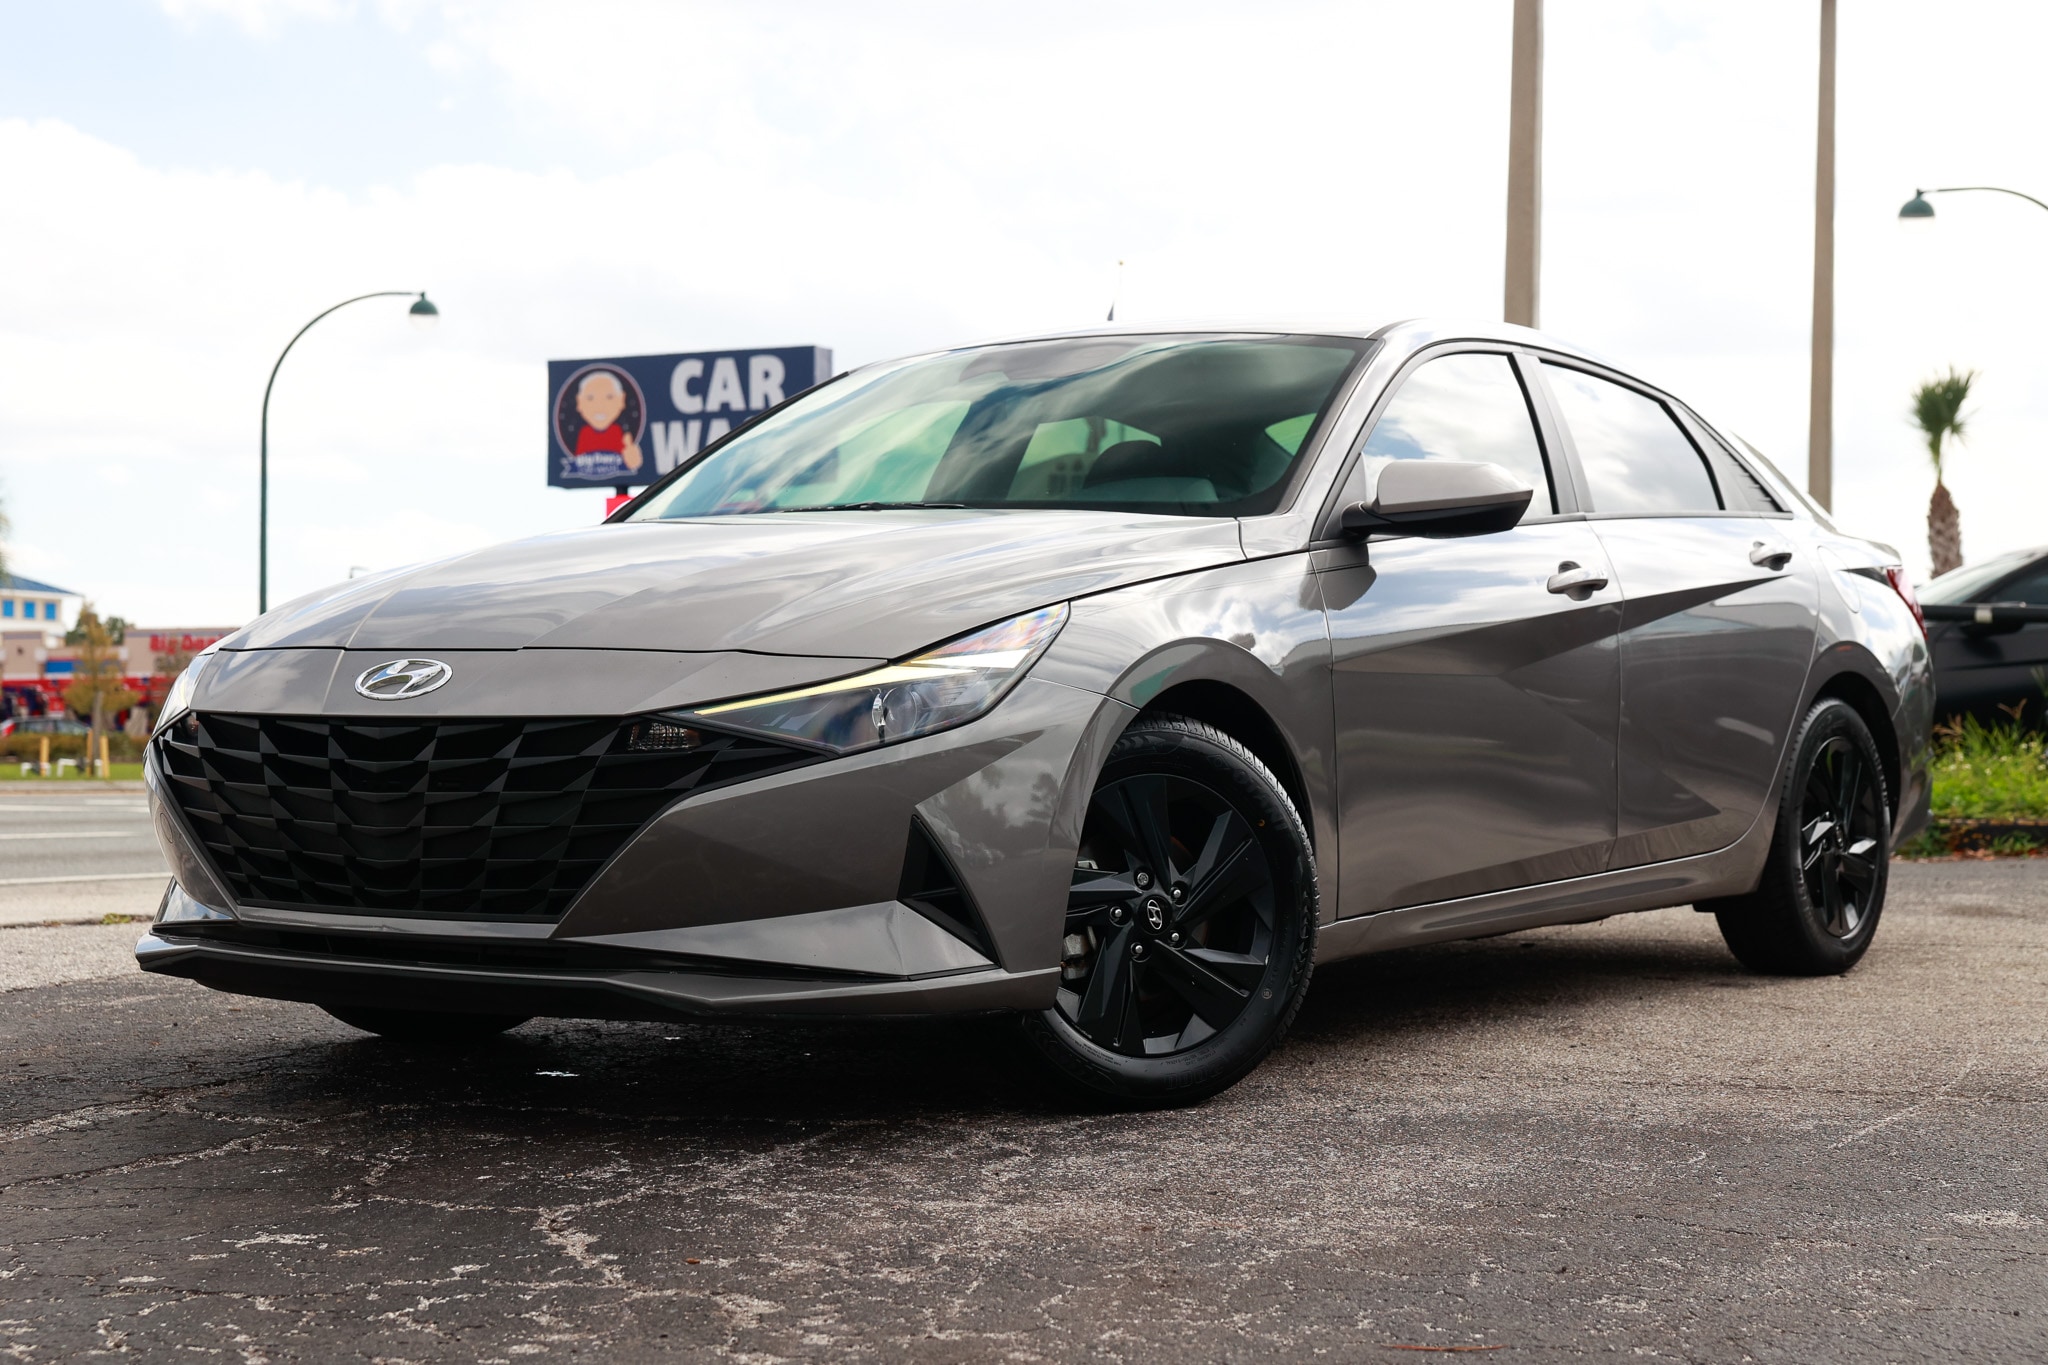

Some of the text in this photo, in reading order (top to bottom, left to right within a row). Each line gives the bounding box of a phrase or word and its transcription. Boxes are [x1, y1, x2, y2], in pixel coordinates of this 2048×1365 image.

[670, 355, 786, 414] CAR
[651, 416, 752, 476] WA
[150, 634, 178, 655] Big
